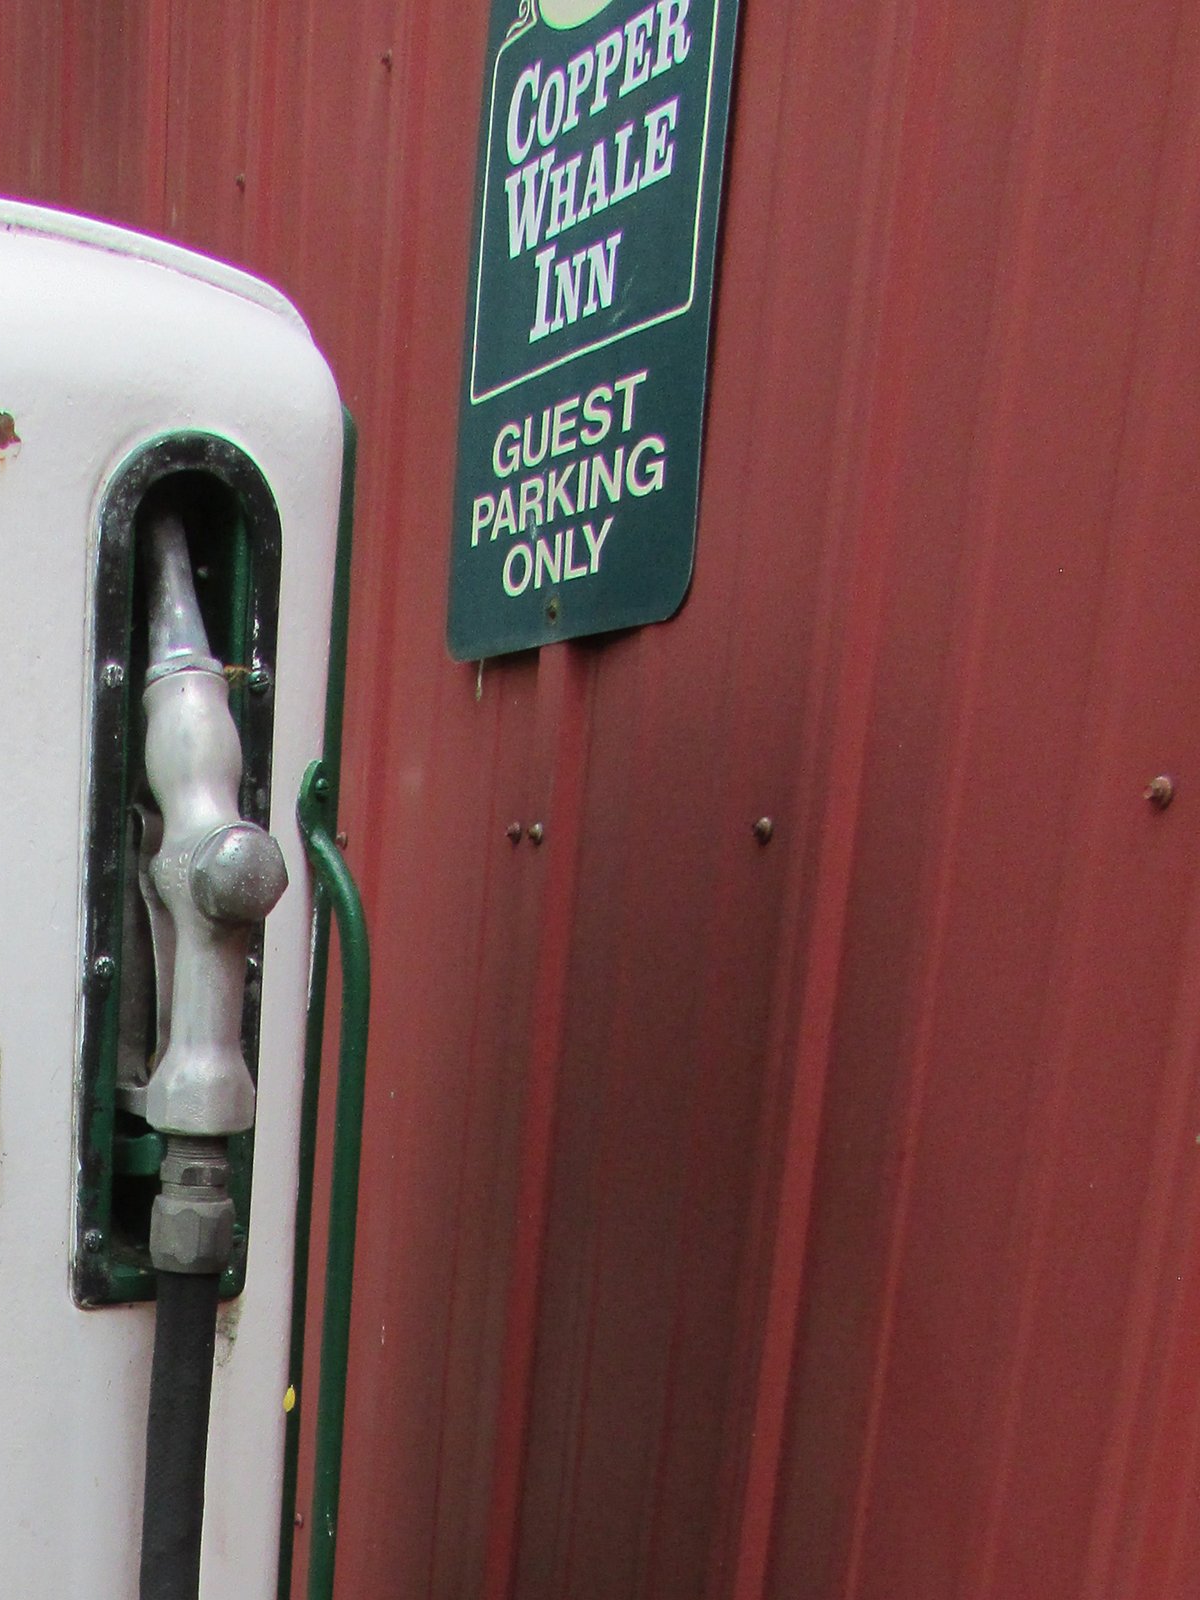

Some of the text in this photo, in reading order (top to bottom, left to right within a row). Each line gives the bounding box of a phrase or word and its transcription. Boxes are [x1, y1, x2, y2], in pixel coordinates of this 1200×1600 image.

[506, 0, 692, 168] COPPER
[504, 98, 679, 259] WHALE
[528, 234, 622, 344] INN
[492, 371, 648, 480] GUEST
[470, 438, 666, 547] PARKING
[502, 518, 613, 600] ONLY
